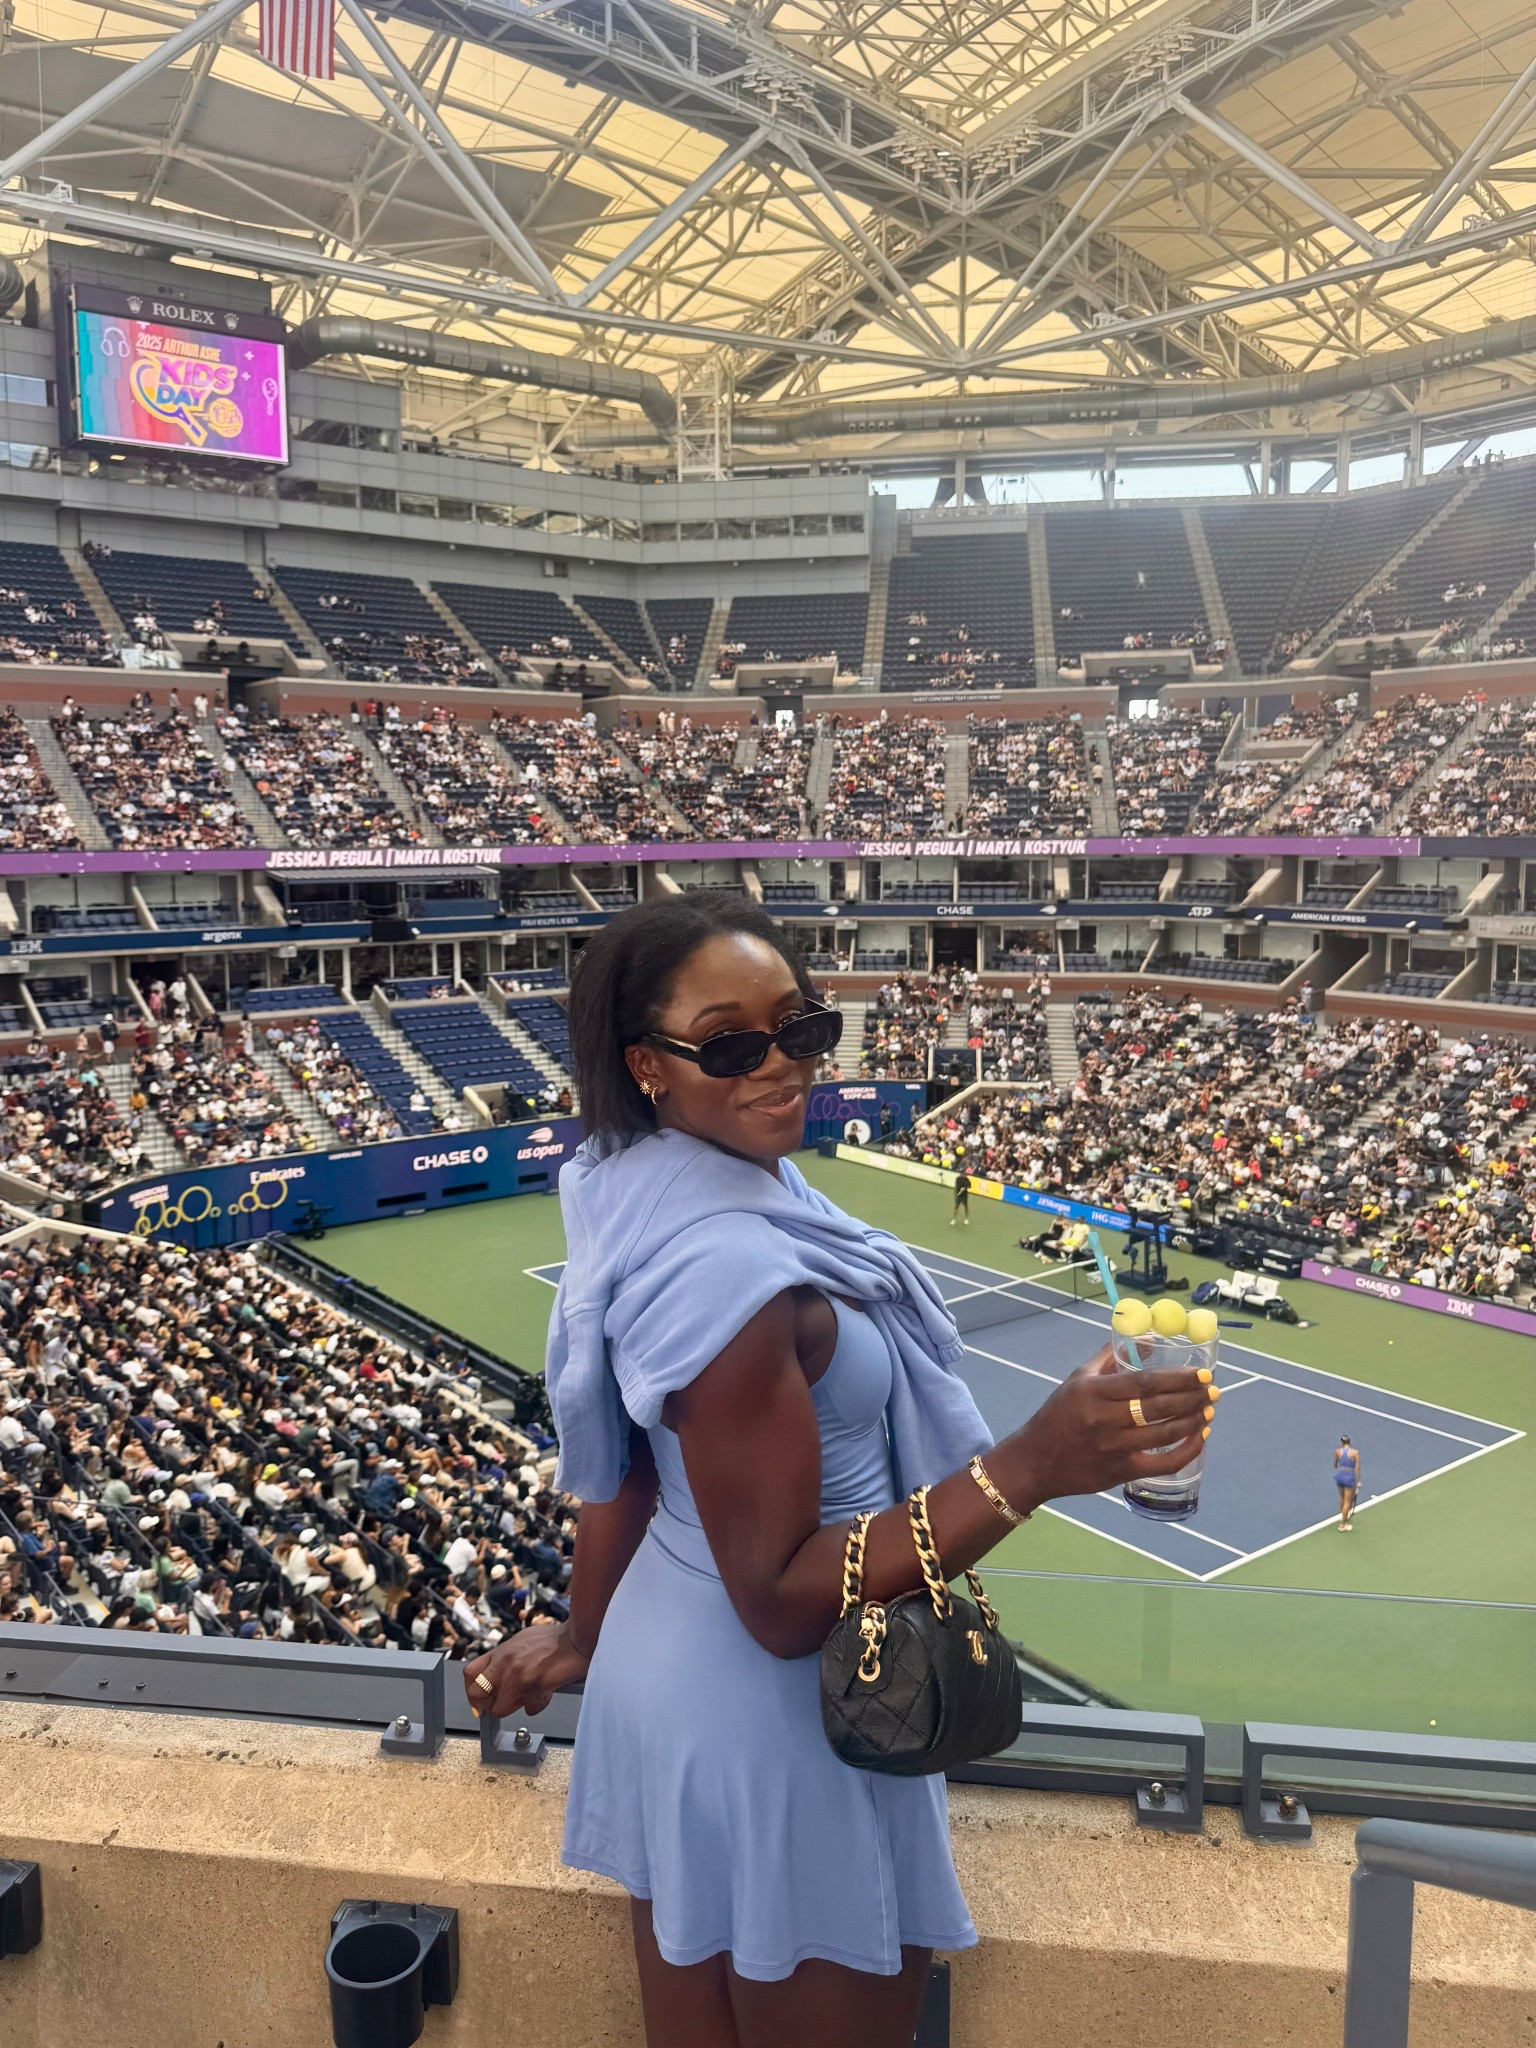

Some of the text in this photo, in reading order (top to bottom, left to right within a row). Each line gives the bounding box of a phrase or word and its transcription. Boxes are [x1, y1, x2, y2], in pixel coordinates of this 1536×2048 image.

[152, 302, 216, 325] ROLEX
[136, 332, 222, 362] 2025 ARTHUR ASHE
[157, 357, 235, 391] KIDS
[156, 384, 206, 407] DAY
[859, 841, 912, 857] JESSICA
[914, 841, 964, 856] PEGULA
[975, 840, 1021, 855] MARTA
[1023, 839, 1088, 855] KOSTYUK
[265, 851, 327, 868] JESSICA
[329, 850, 383, 867] PEGULA
[393, 849, 441, 866] MARTA
[442, 848, 502, 864] KOSTYUK
[936, 905, 974, 916] CHASE
[1187, 906, 1212, 917] ATP
[1290, 912, 1367, 924] AMERICAN EXPRESS
[10, 939, 43, 954] IBM
[413, 1149, 471, 1171] CHASE
[517, 1143, 564, 1161] us open
[250, 1166, 306, 1185] Emirates
[1091, 1211, 1109, 1224] IHG
[1355, 1277, 1390, 1294] CHASE
[1446, 1298, 1475, 1317] IBM
